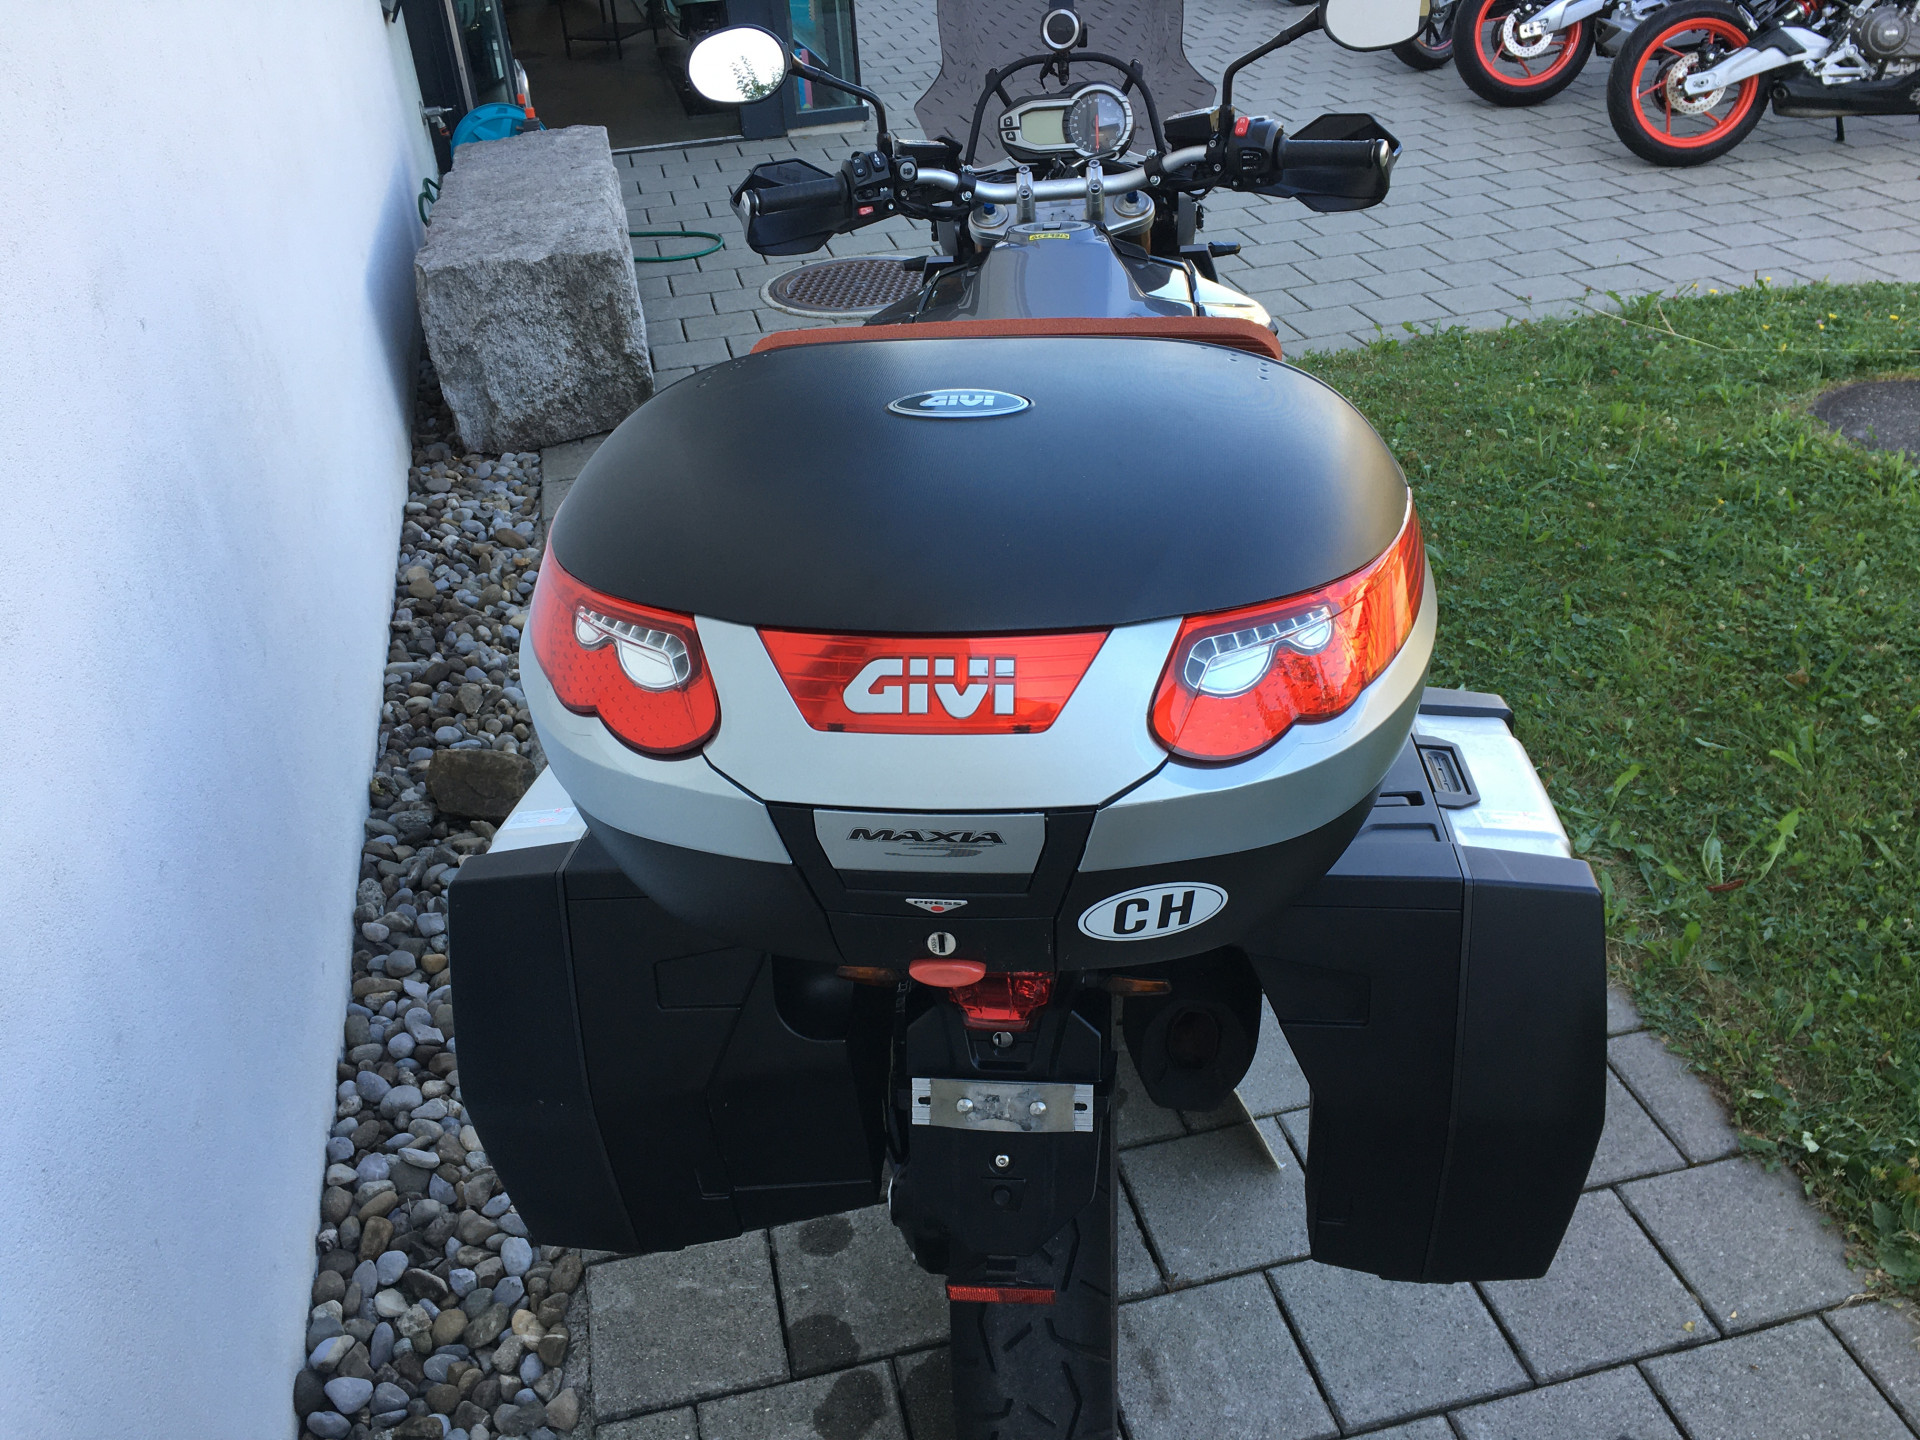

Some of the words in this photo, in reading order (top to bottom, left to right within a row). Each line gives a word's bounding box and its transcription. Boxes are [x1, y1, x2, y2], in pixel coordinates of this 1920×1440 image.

[919, 395, 995, 407] GIVI
[843, 657, 1015, 719] GIVI
[846, 827, 1006, 845] MAXIA
[1113, 889, 1196, 934] CH
